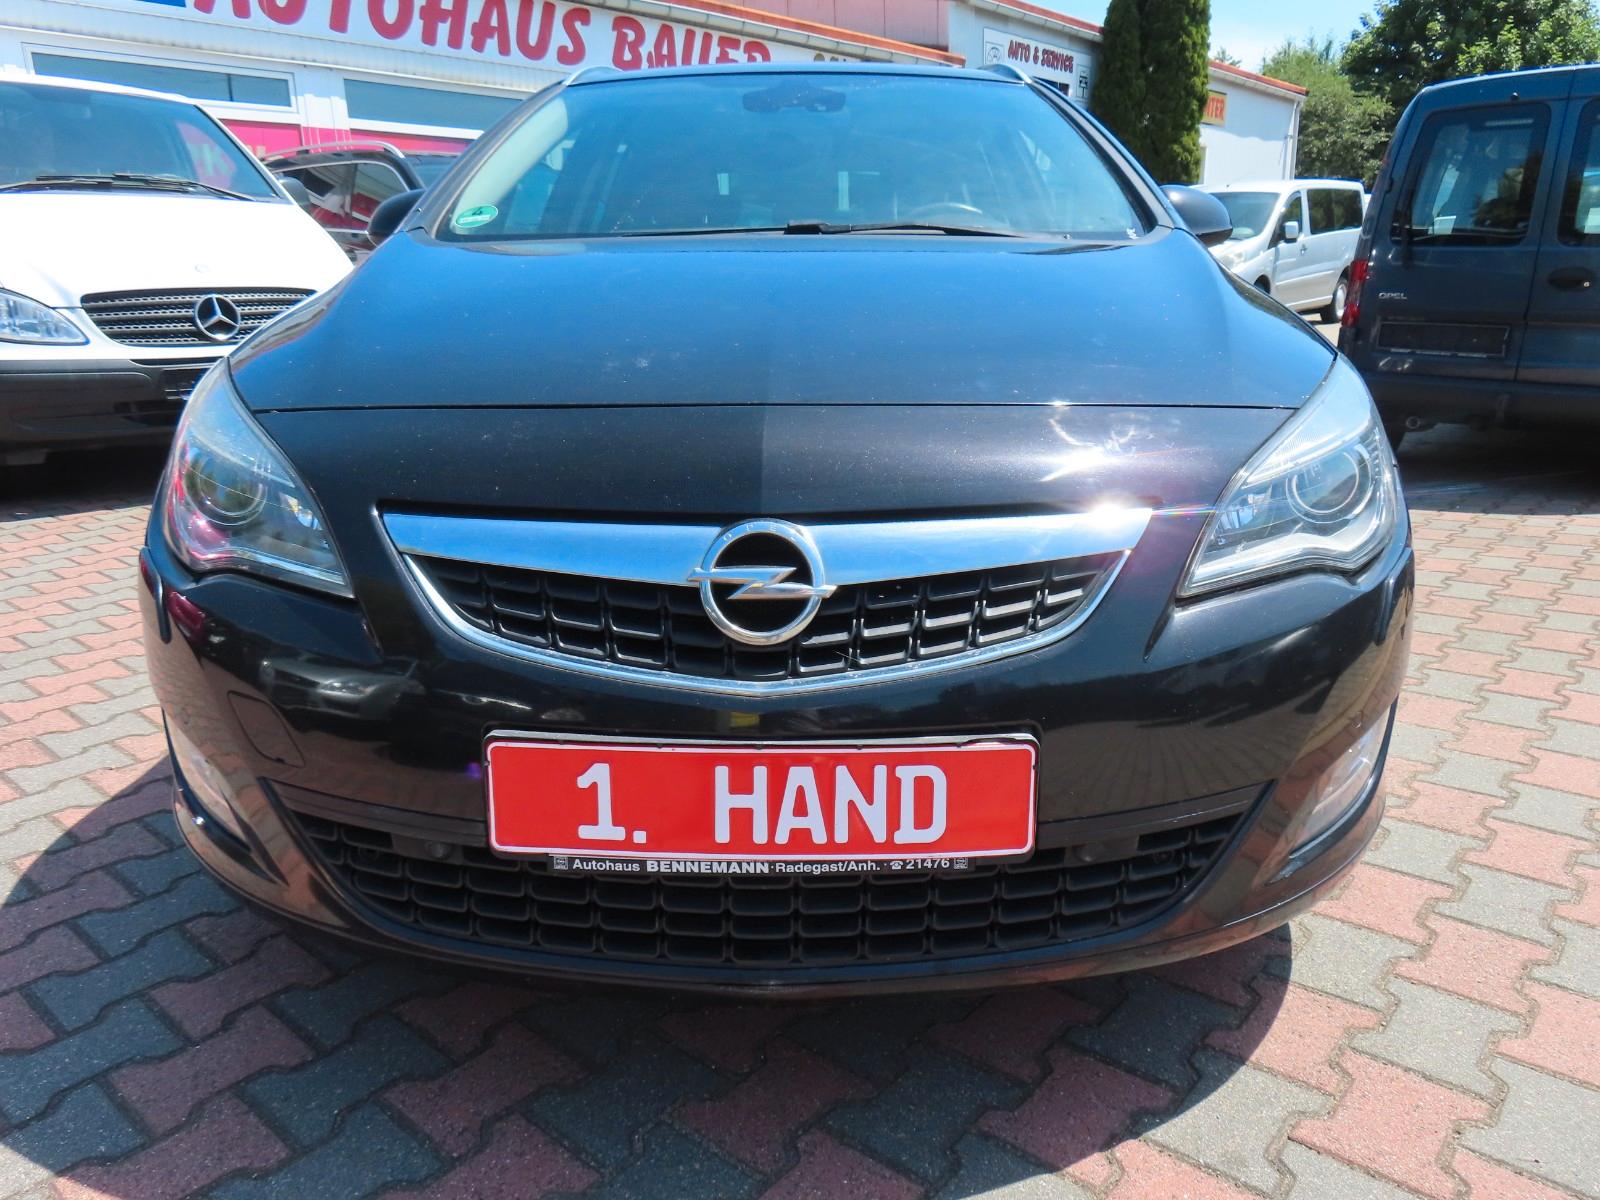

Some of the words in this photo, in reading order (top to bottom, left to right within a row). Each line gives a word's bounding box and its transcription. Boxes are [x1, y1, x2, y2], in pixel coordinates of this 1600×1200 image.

[194, 0, 591, 66] OHAUS
[1008, 40, 1031, 63] AUTO
[1033, 46, 1040, 65] &
[1041, 48, 1074, 73] SERVICE
[576, 762, 648, 844] 1.
[714, 764, 948, 846] HAND
[572, 859, 641, 872] Autohaus
[646, 860, 769, 874] BENNEMANN
[775, 860, 881, 875] Radegast/Anh.
[905, 858, 950, 870] 21476
